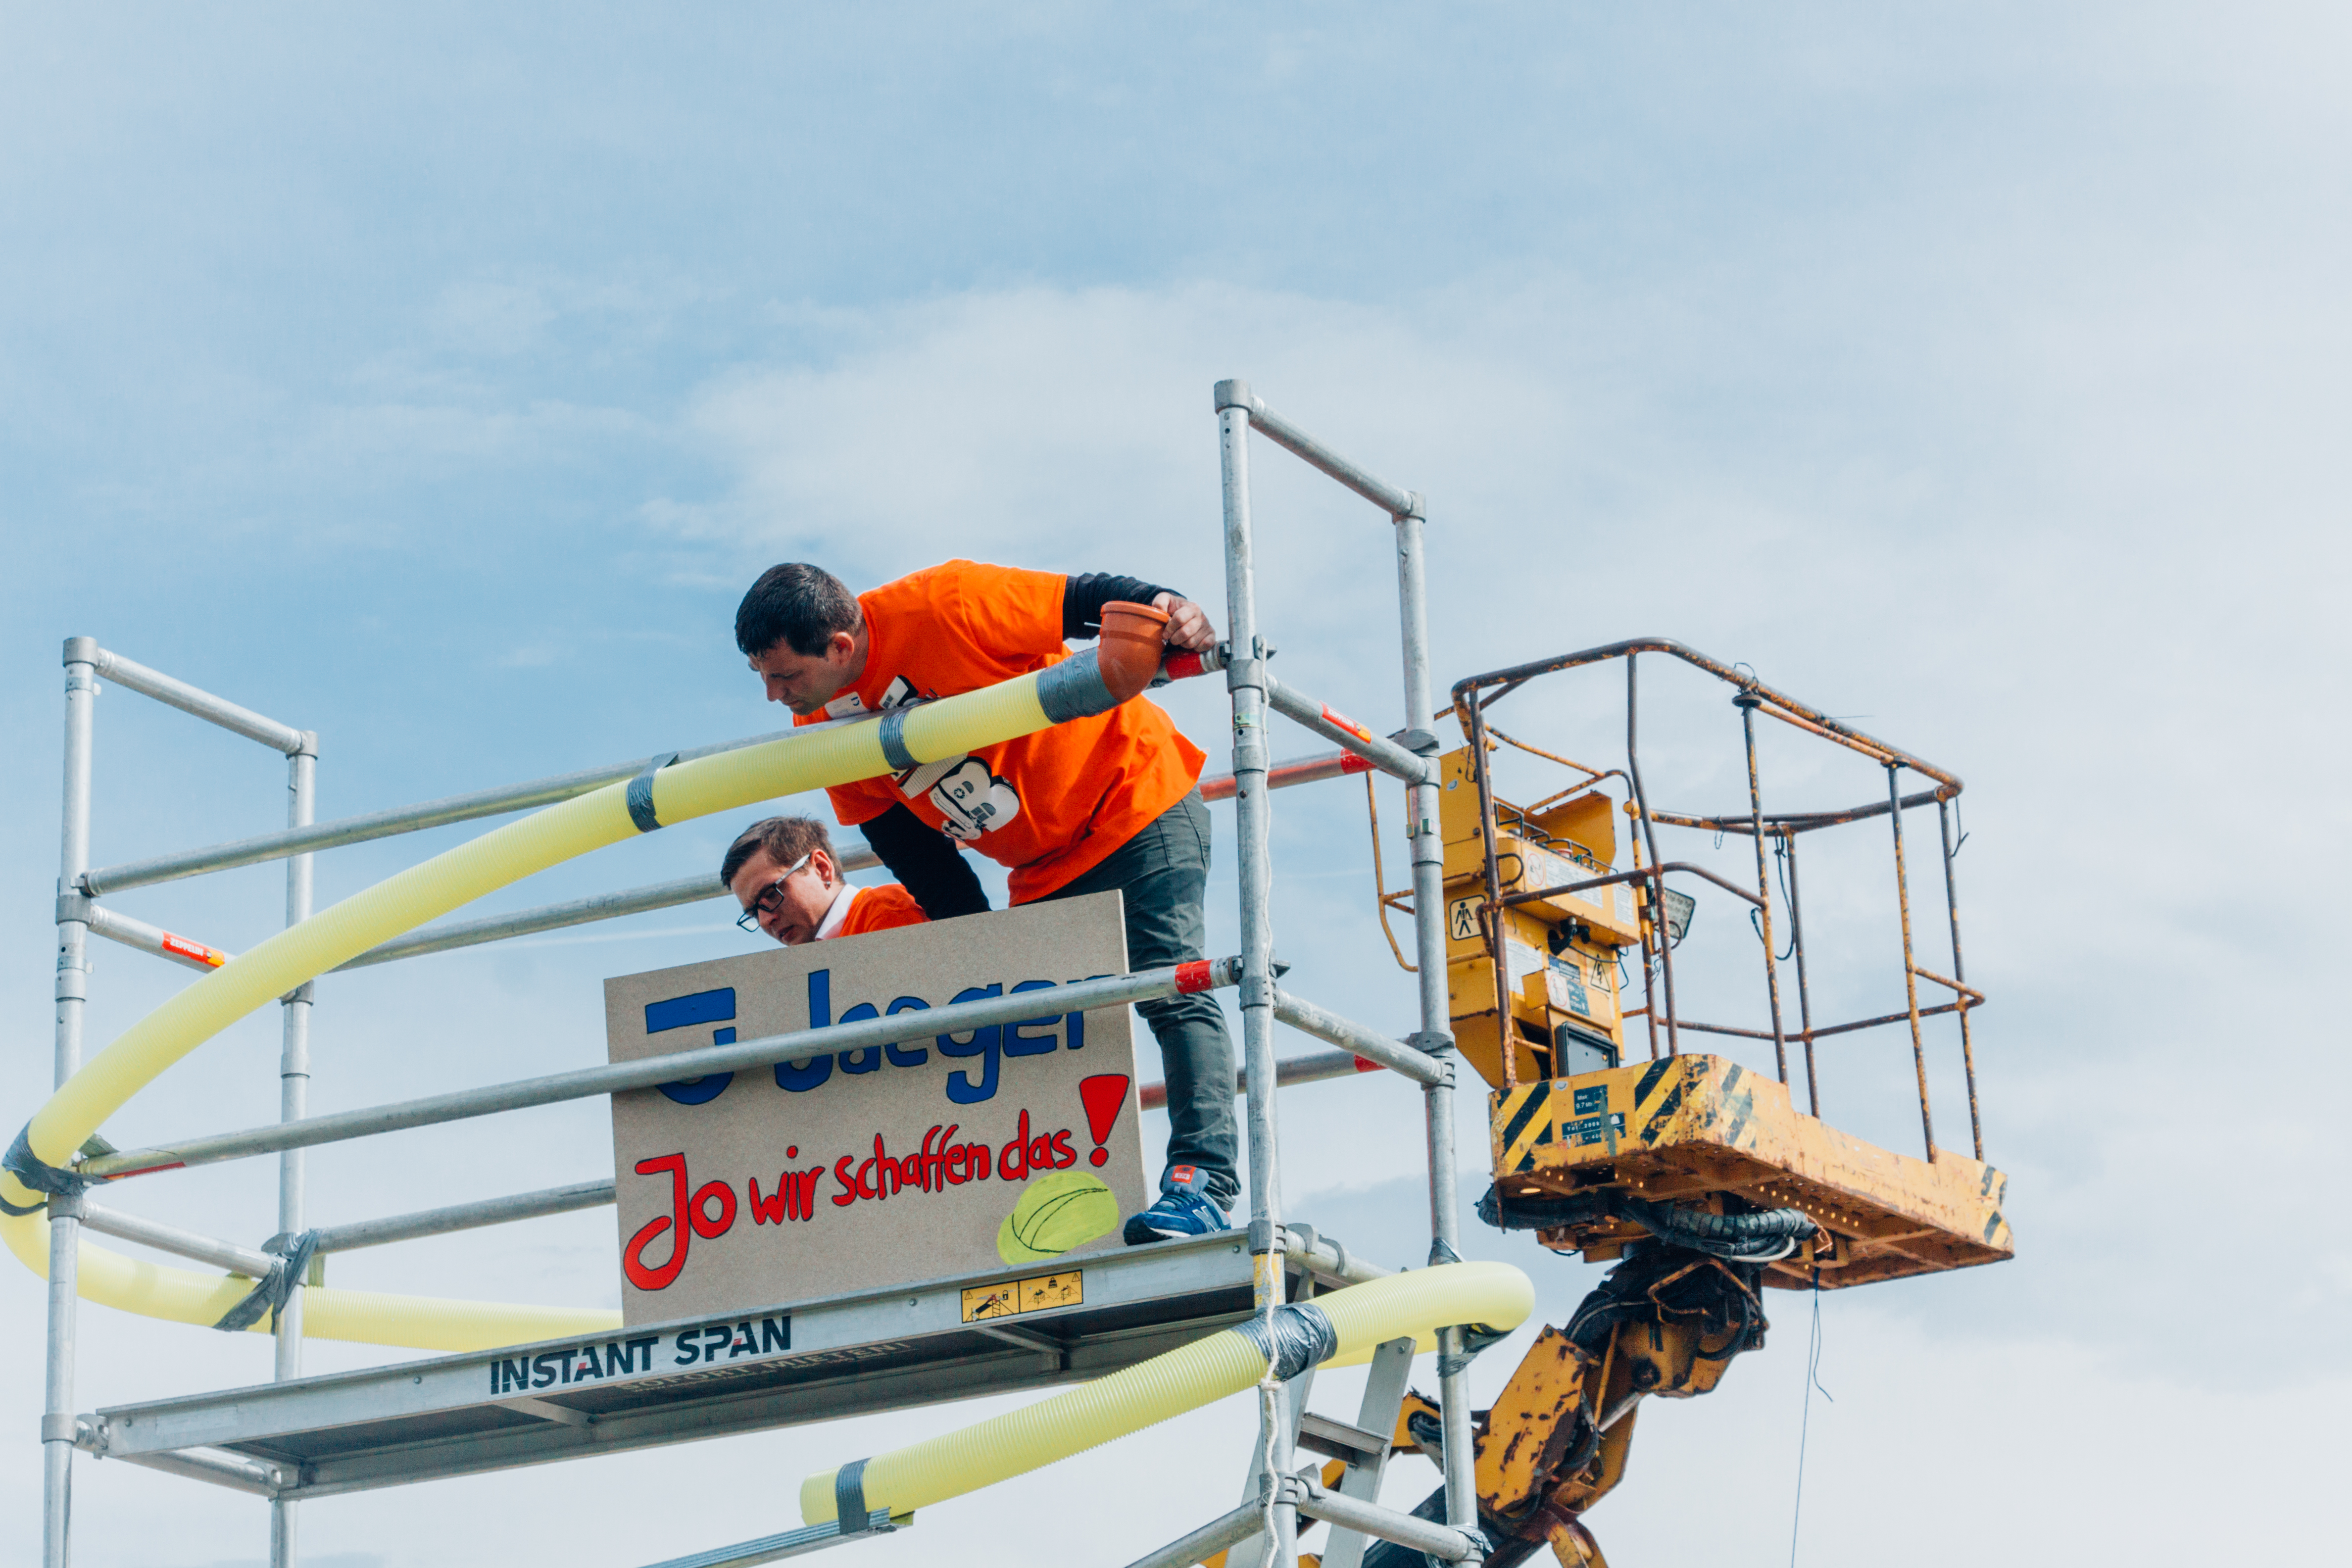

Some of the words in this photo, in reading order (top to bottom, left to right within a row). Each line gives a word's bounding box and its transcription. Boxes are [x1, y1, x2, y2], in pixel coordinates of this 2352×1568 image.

[170, 937, 204, 956] ZEPPELIN
[623, 1152, 737, 1291] Jo
[748, 1145, 825, 1225] wir
[832, 1124, 991, 1207] schaffen
[490, 1336, 659, 1395] INSTANT
[673, 1315, 791, 1366] SPAN
[616, 1366, 750, 1390] SOFORT
